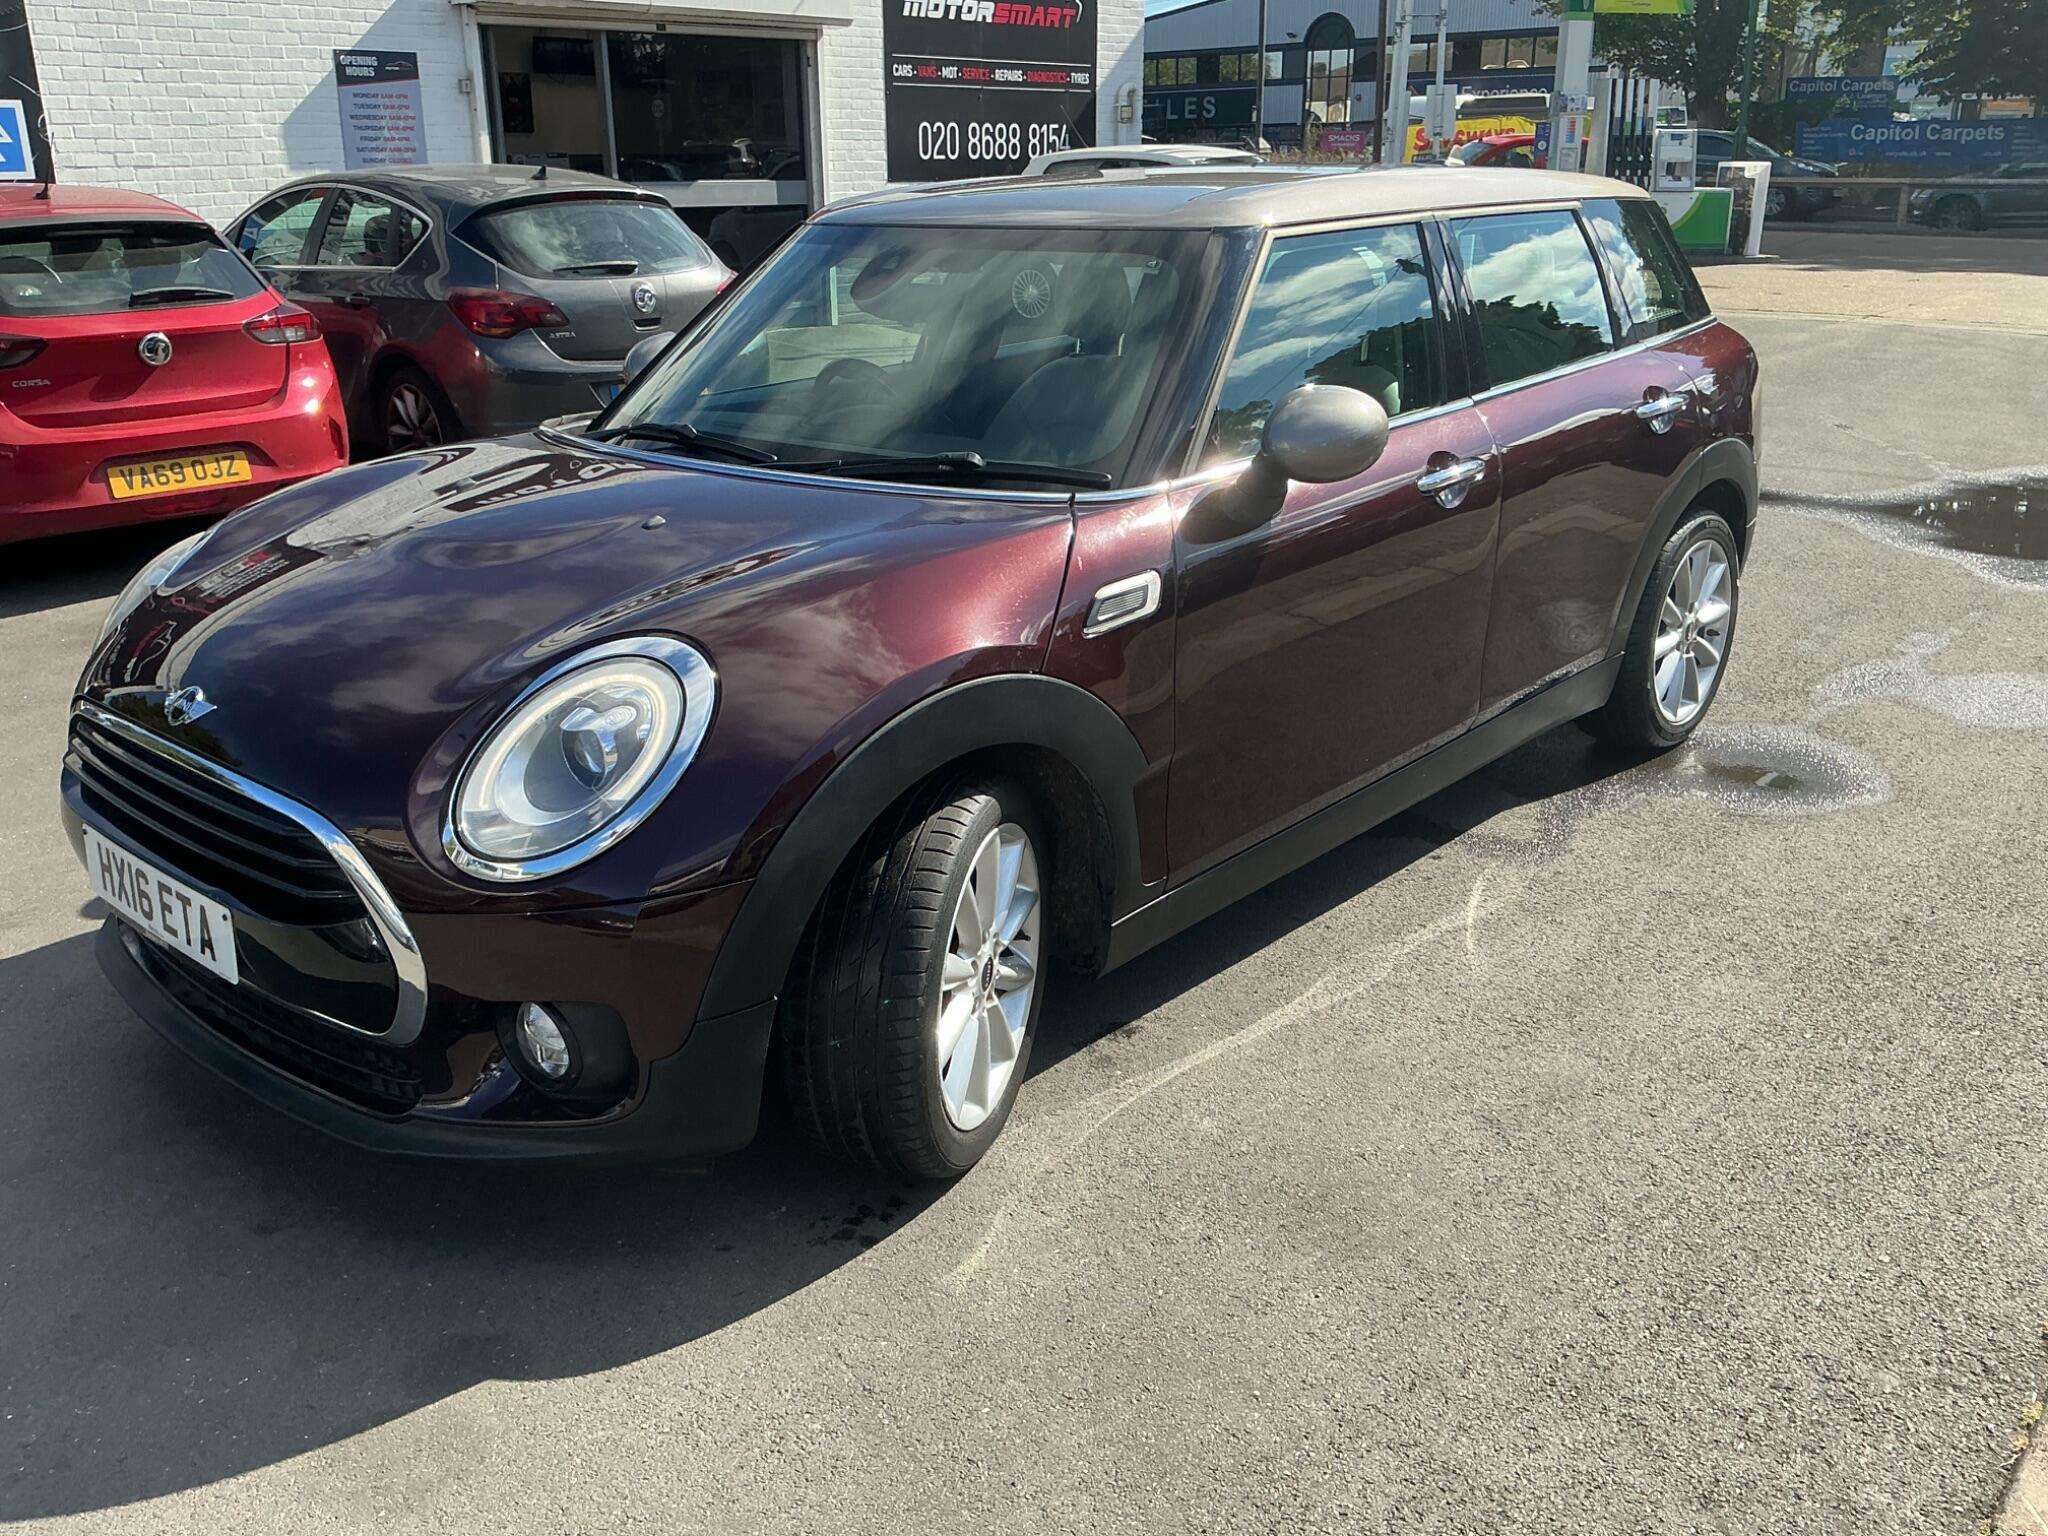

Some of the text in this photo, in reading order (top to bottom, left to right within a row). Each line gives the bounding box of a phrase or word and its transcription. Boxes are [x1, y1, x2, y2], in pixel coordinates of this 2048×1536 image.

[340, 55, 378, 66] OPENING
[345, 66, 375, 77] HOURS
[892, 63, 913, 77] CARS
[941, 65, 958, 79] MOT
[962, 67, 990, 80] SERVICE
[994, 69, 1023, 82] REPAIRS
[1070, 72, 1090, 84] TYRES
[1789, 79, 1894, 94] Capitol Carpets
[918, 121, 960, 160] 020
[967, 122, 1021, 160] 8688
[1850, 124, 1919, 143] Capitol
[1926, 124, 2005, 143] Carpets
[549, 331, 576, 339] ASTRA
[11, 379, 51, 388] CORSA
[120, 462, 187, 490] VA69
[97, 842, 217, 962] HX16 ETA
